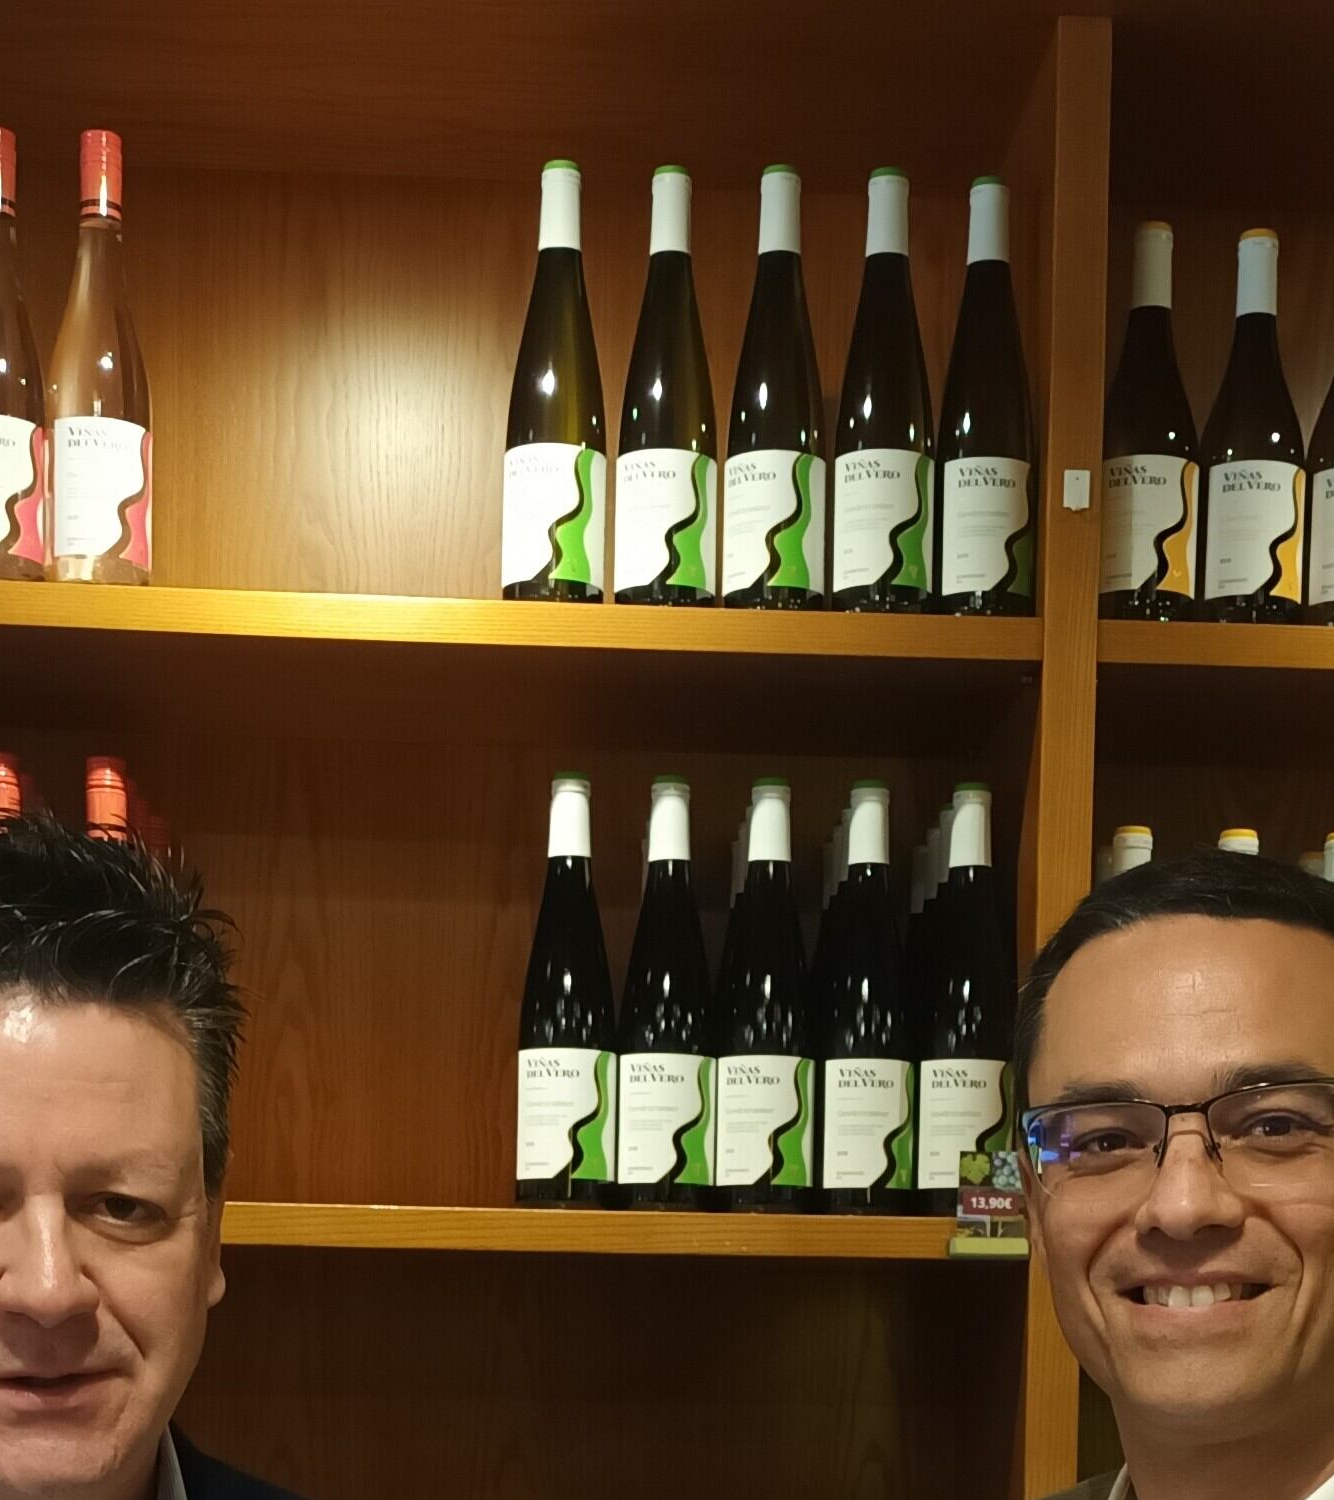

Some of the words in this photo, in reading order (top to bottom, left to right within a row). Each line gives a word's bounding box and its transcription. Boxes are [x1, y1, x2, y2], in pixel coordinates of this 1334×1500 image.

[959, 464, 998, 476] VIÑAS
[1223, 470, 1263, 482] VIÑAS
[527, 1056, 561, 1068] VIÑAS
[629, 1061, 665, 1073] VIÑAS
[727, 1064, 761, 1076] VIÑAS
[839, 1066, 877, 1078] VIÑAS
[933, 1067, 969, 1078] VIÑAS
[970, 1196, 1012, 1210] 13,90€
